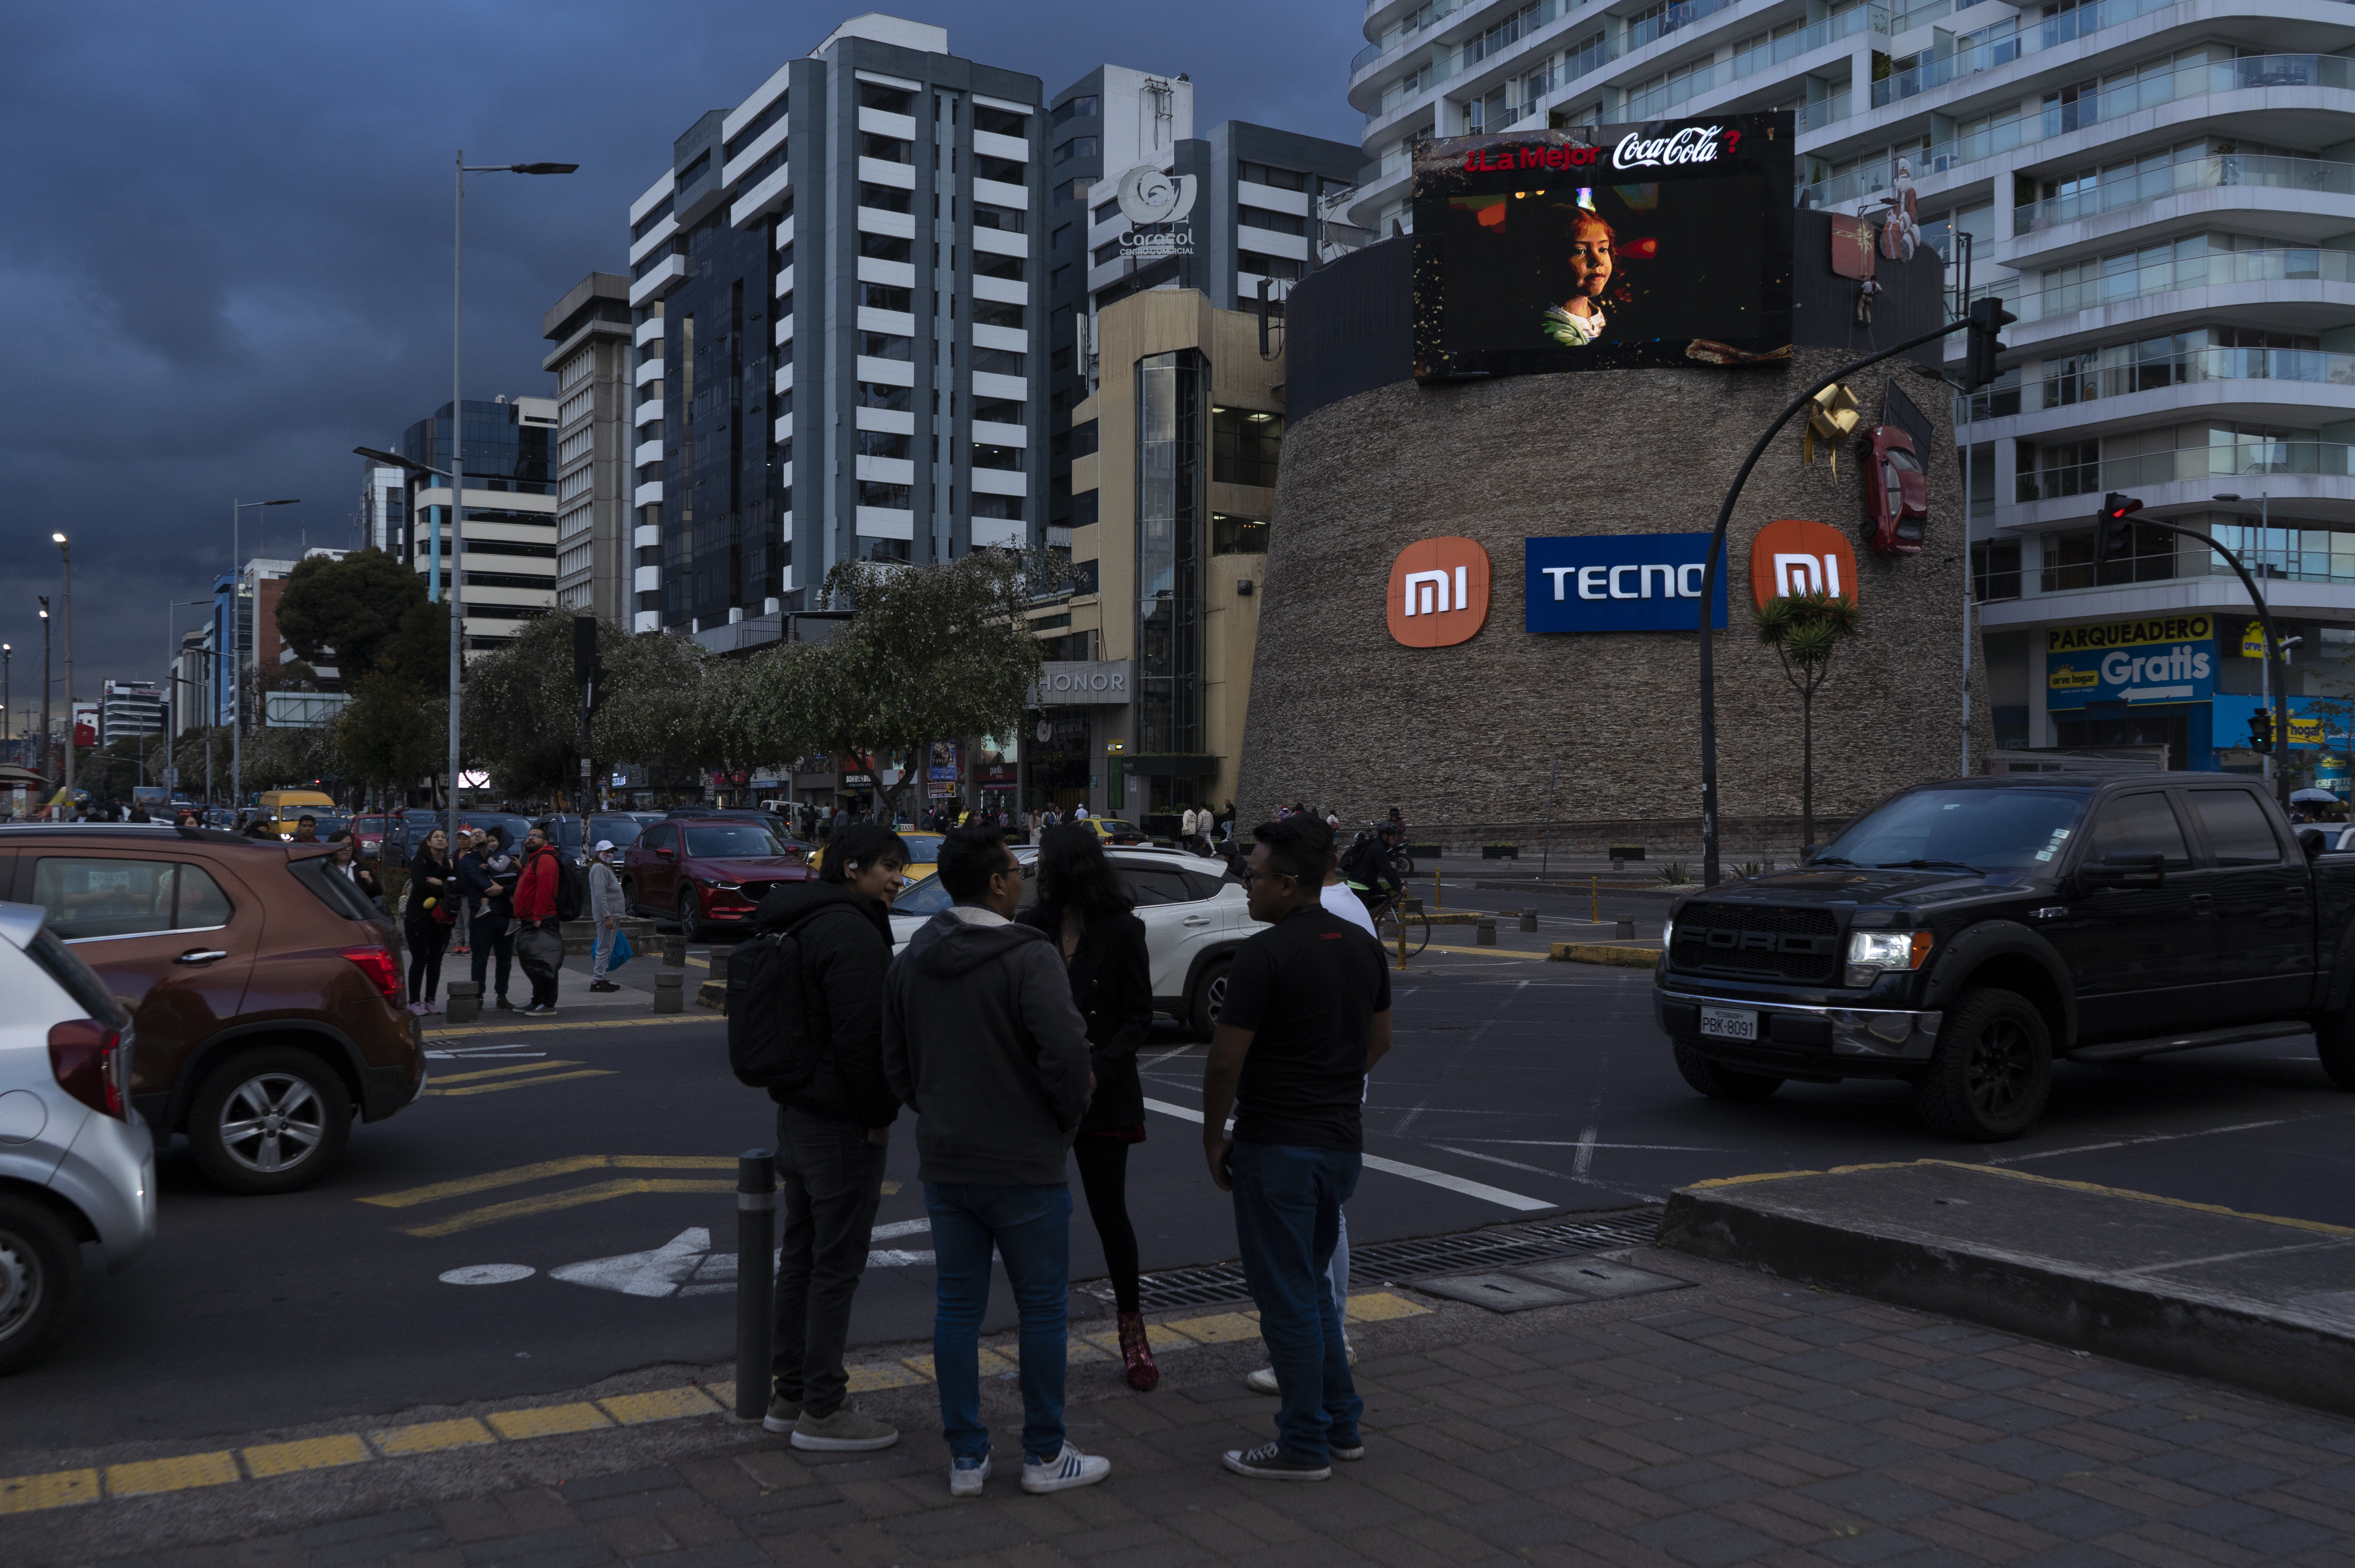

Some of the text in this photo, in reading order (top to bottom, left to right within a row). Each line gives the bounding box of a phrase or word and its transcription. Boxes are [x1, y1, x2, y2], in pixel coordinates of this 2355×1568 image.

[1464, 150, 1515, 172] ¿La
[1520, 144, 1601, 171] Mejor
[1613, 125, 1724, 169] Coca-Cola
[1119, 228, 1195, 246] Caracol
[1542, 564, 1706, 600] TECNO
[2050, 617, 2209, 650] PARQUEADERO
[2244, 642, 2262, 651] orve
[2101, 645, 2211, 685] Gratis
[1039, 674, 1125, 691] HONOR
[2072, 675, 2095, 684] hogar
[1053, 719, 1084, 733] Caracol
[2291, 723, 2321, 738] hogar
[1675, 926, 1820, 954] FORD
[1702, 1017, 1753, 1037] PBK-8091
